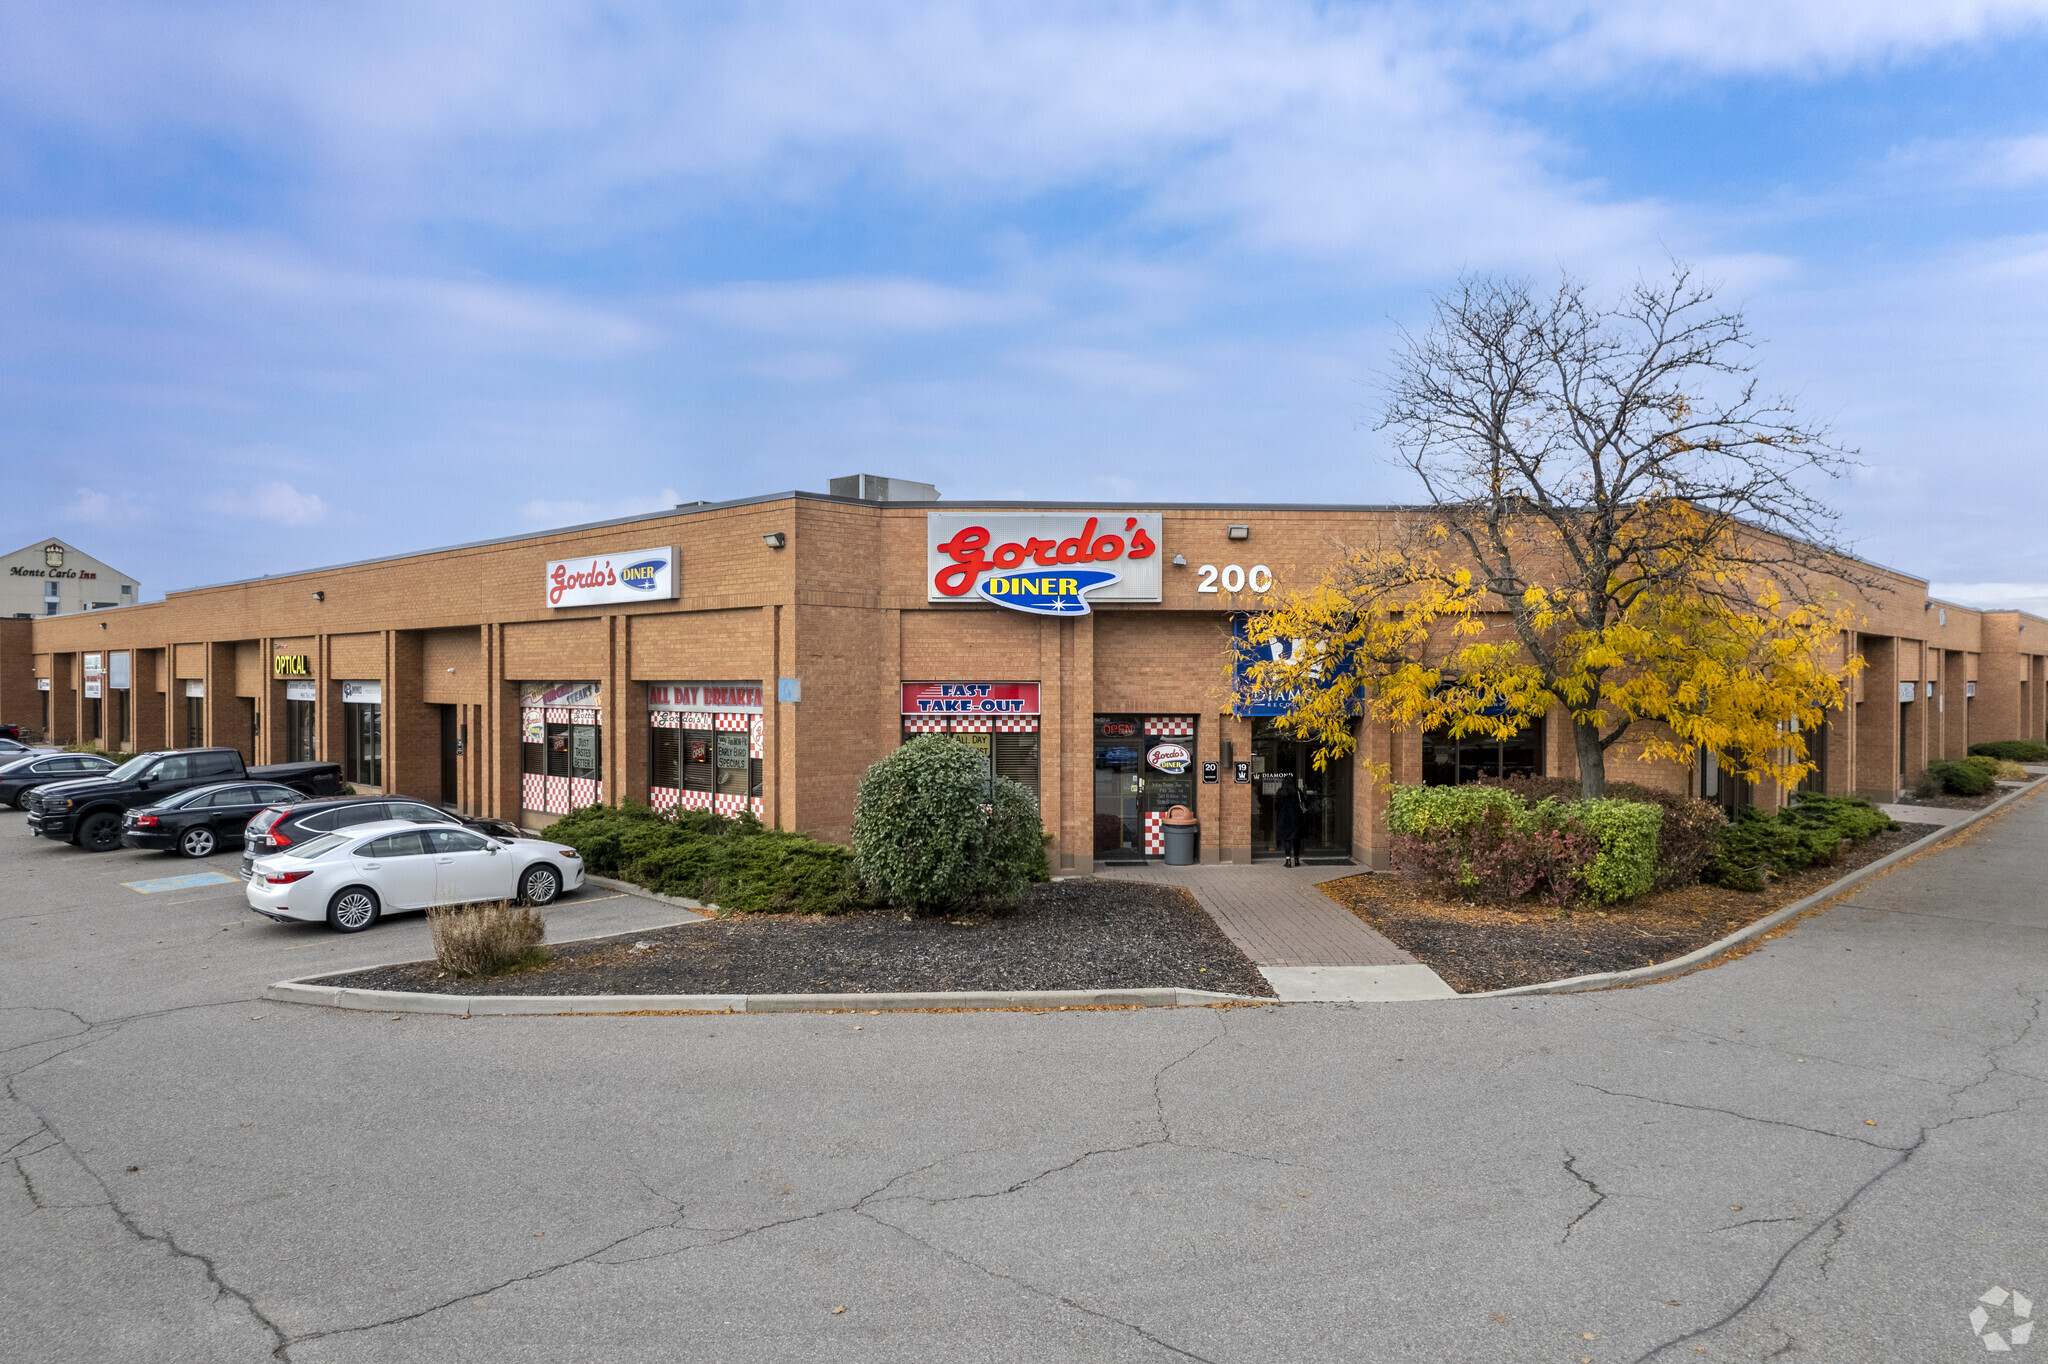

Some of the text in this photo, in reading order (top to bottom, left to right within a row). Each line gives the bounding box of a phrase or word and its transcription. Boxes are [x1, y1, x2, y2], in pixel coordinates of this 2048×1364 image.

[934, 516, 1156, 597] Gordo's
[10, 566, 97, 580] Monte Carlo Inn
[1198, 564, 1273, 594] 200
[549, 560, 654, 605] Gordo's DINER
[989, 577, 1079, 597] DINER
[274, 654, 307, 675] OPTICAL
[566, 684, 593, 706] STEAKS
[649, 687, 763, 707] ALL DAY BREAKFA
[940, 684, 991, 698] FAST
[917, 699, 1025, 713] TAKE-OUT
[1102, 724, 1134, 736] OPEN
[972, 735, 987, 745] DAY
[575, 747, 592, 758] TASTES
[692, 746, 705, 759] OPEN
[718, 746, 746, 758] EARLY BIRD
[1151, 748, 1185, 765] Gordo's
[719, 758, 746, 769] SPECIALS
[1161, 761, 1182, 769] DINER
[1205, 763, 1216, 772] 20
[1238, 763, 1248, 772] 19
